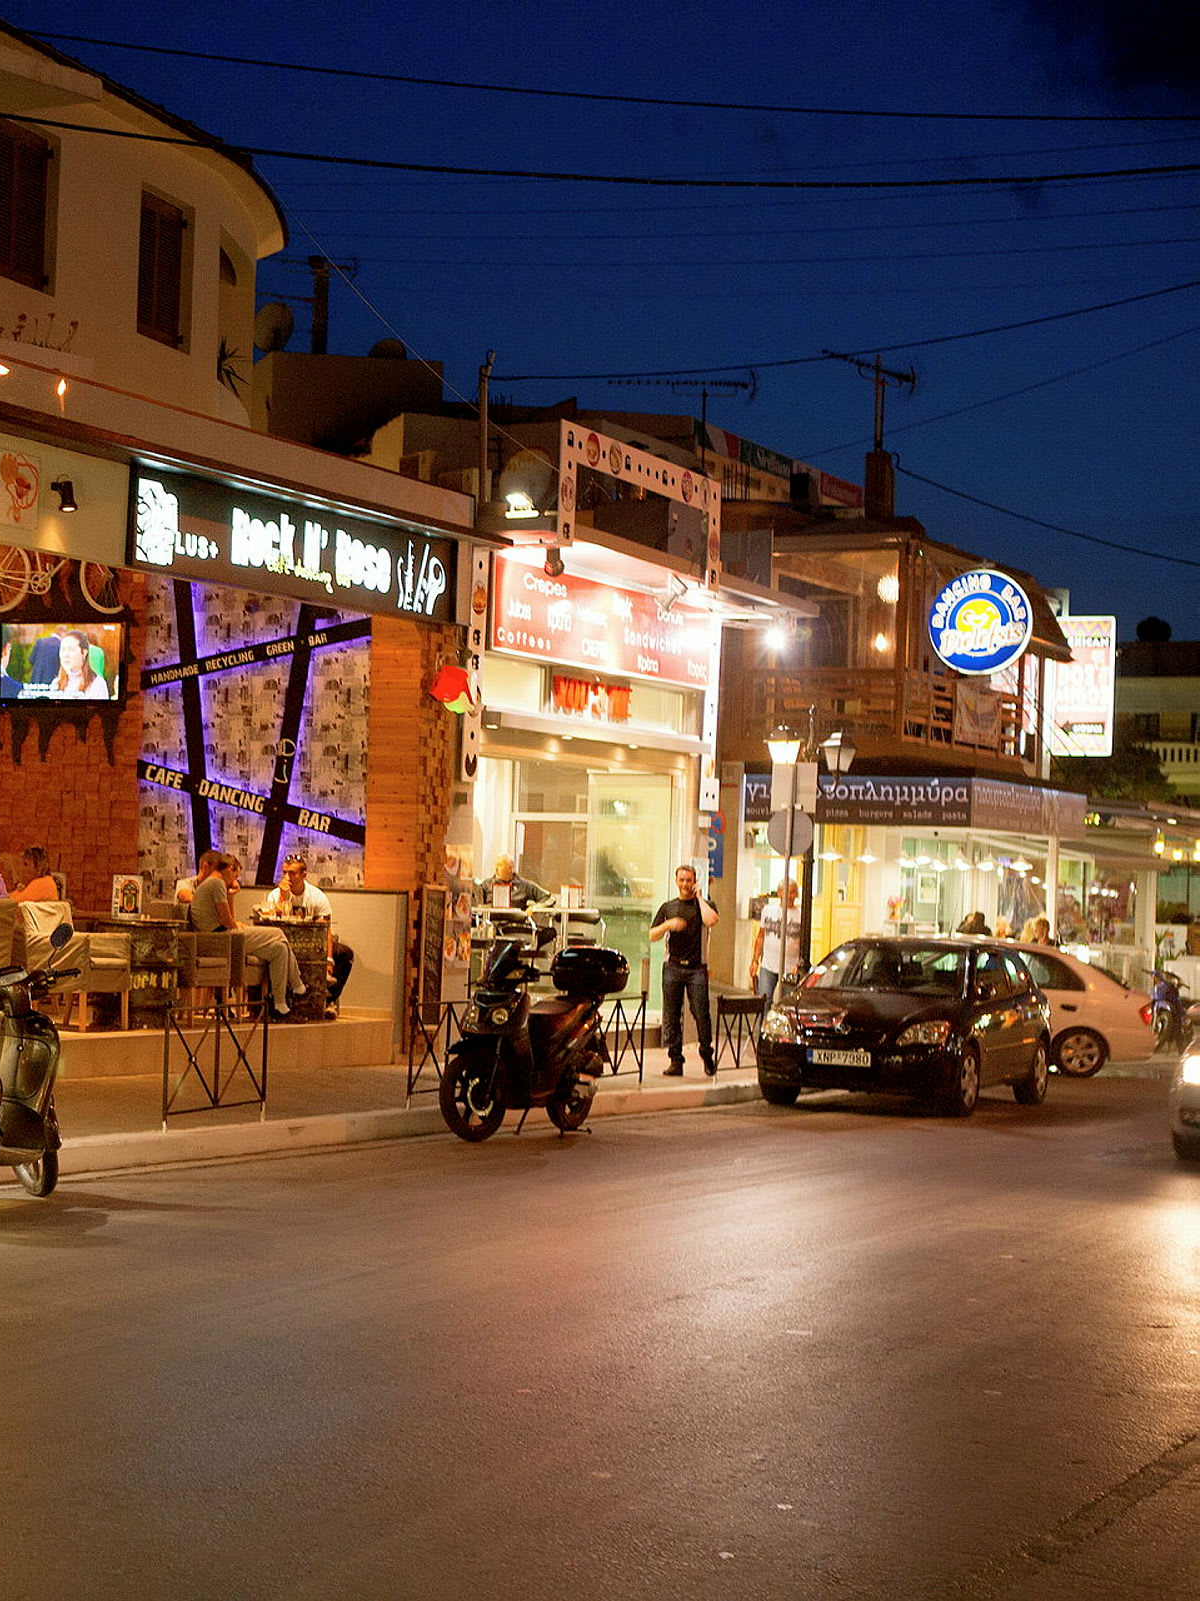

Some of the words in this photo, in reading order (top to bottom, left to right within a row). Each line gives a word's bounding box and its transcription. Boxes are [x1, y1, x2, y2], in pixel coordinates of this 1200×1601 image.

[523, 572, 568, 598] Crepes
[931, 573, 991, 629] DANCING
[1000, 584, 1027, 621] BAR
[150, 664, 200, 684] HANDMADE
[205, 651, 255, 671] RECYCLING
[266, 640, 295, 657] GREEN
[308, 633, 328, 647] BAR
[145, 764, 183, 790] CAFE
[198, 779, 266, 813] DANCING
[298, 809, 332, 833] BAR
